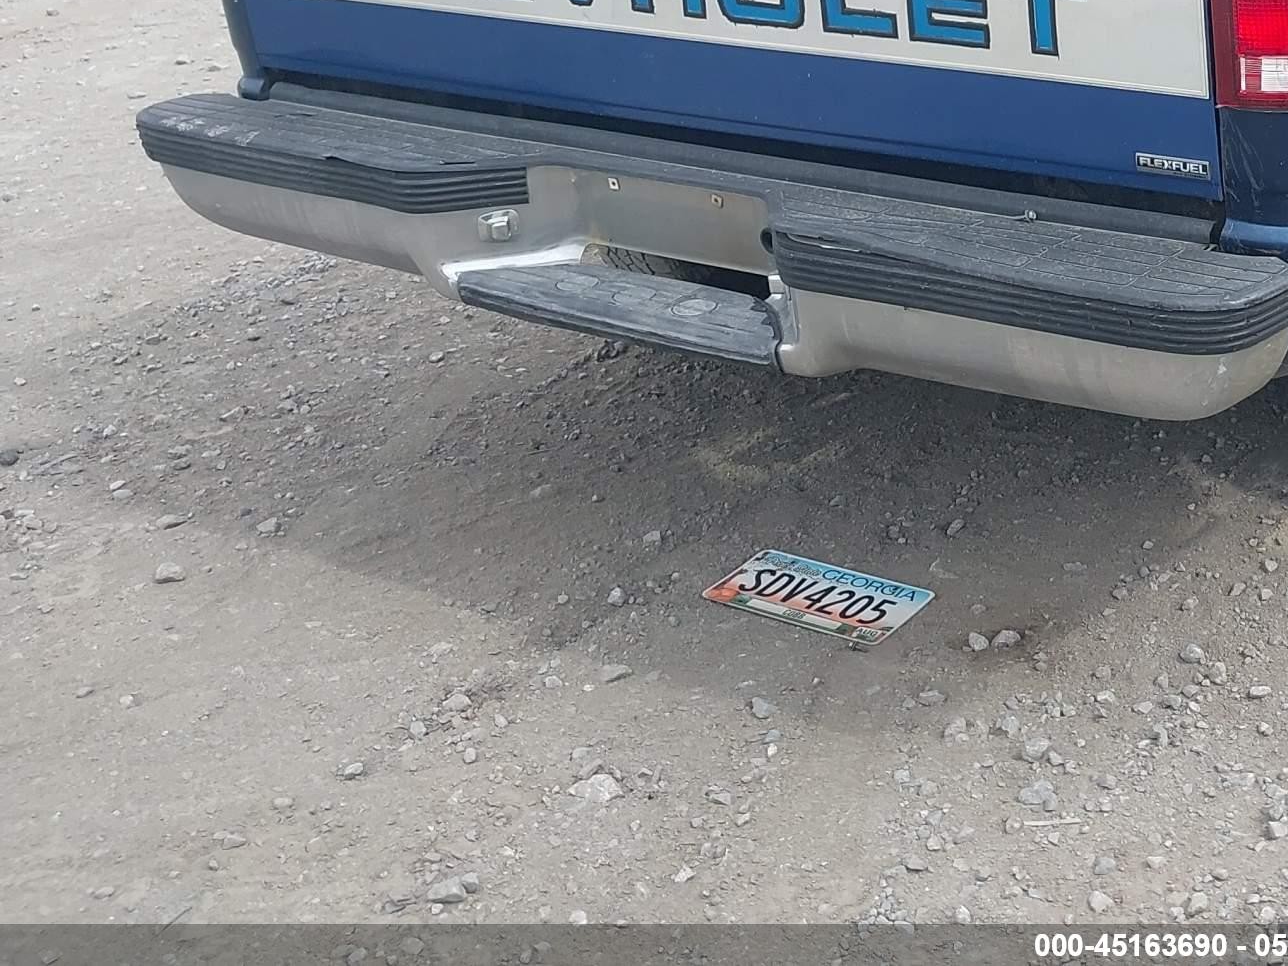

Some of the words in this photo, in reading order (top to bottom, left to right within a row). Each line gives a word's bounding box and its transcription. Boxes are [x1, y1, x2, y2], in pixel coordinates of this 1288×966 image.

[1139, 156, 1207, 175] FLEXFUEL
[739, 568, 897, 624] SDV4205
[822, 569, 916, 602] GEORGIA
